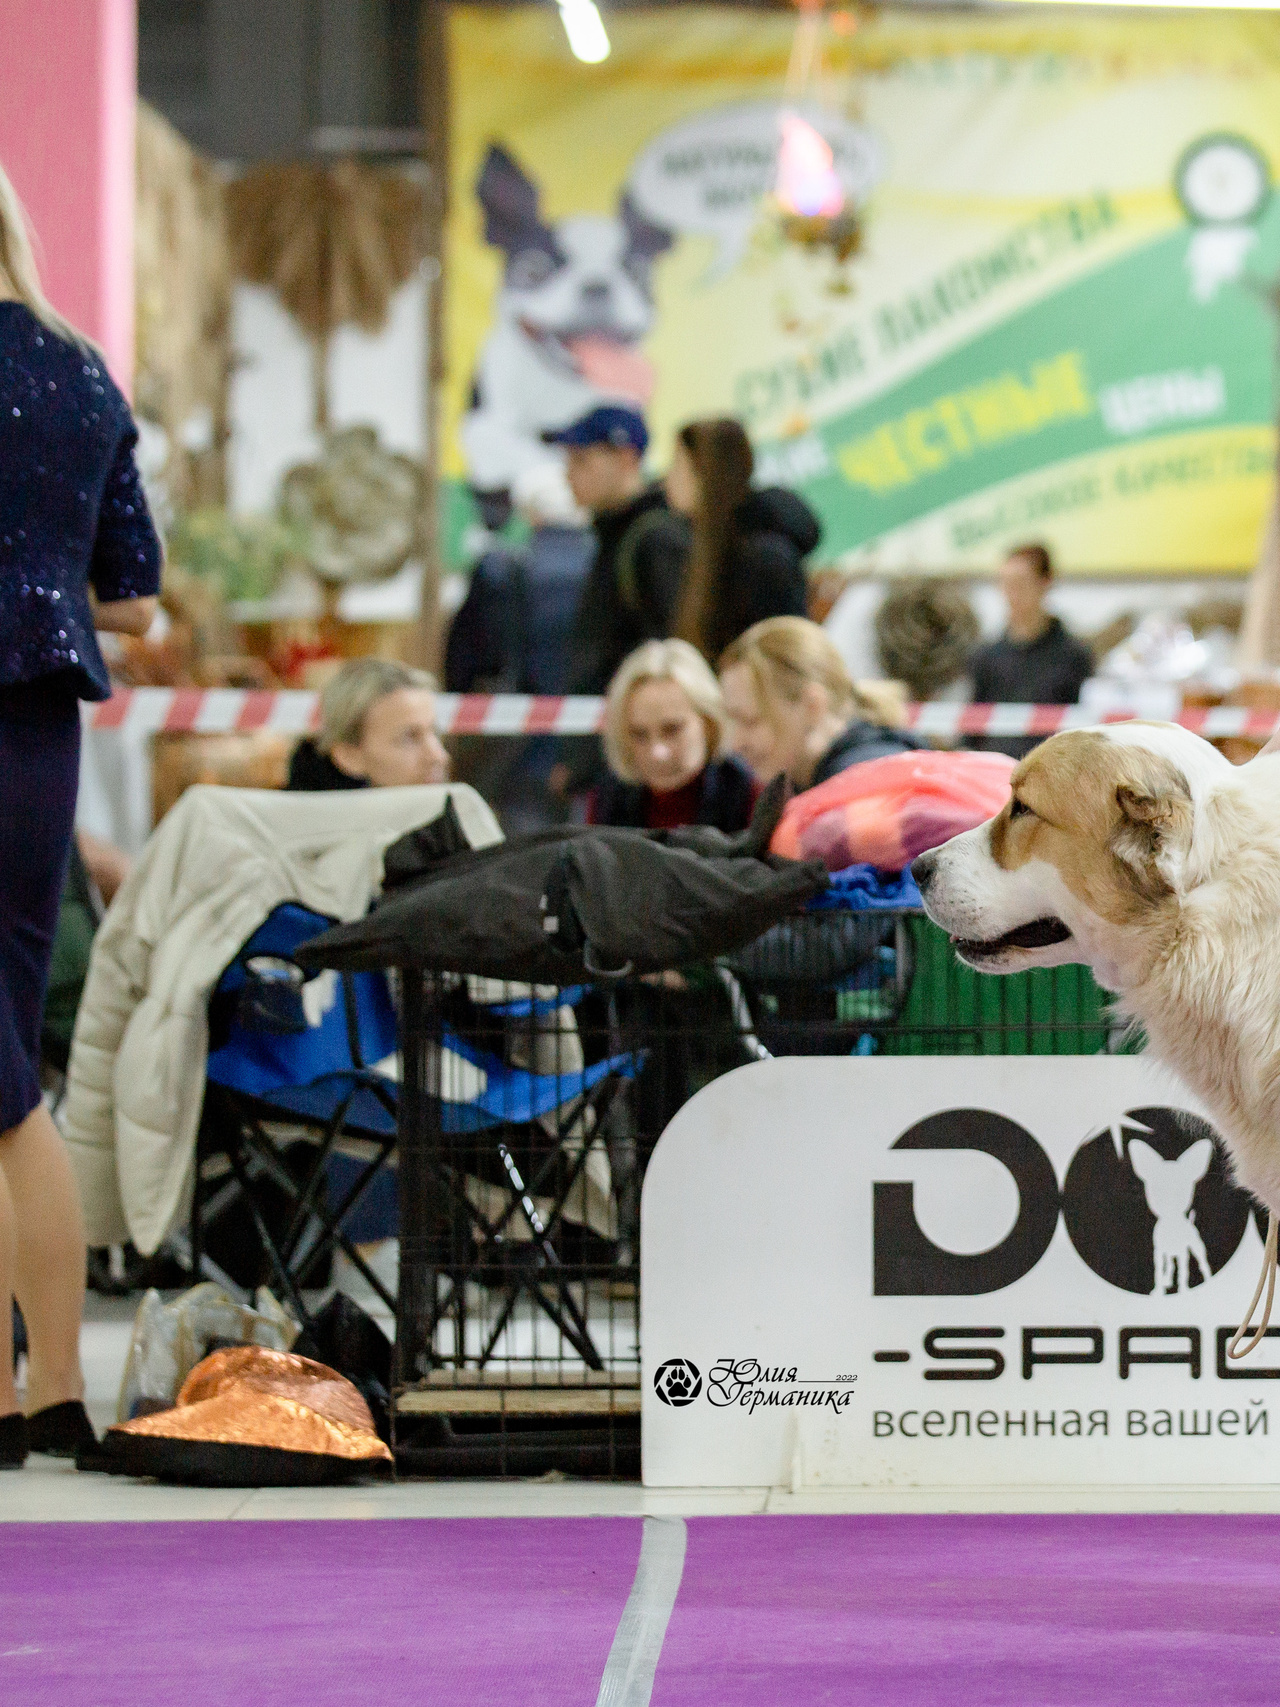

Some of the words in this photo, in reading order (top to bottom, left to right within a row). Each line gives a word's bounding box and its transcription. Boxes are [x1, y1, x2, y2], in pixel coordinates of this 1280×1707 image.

[836, 349, 1092, 494] ЧЕСТНЫЕ
[1102, 366, 1226, 435] ЦЕНЫ
[873, 1409, 1109, 1437] вселенная
[1127, 1401, 1268, 1437] вашей
